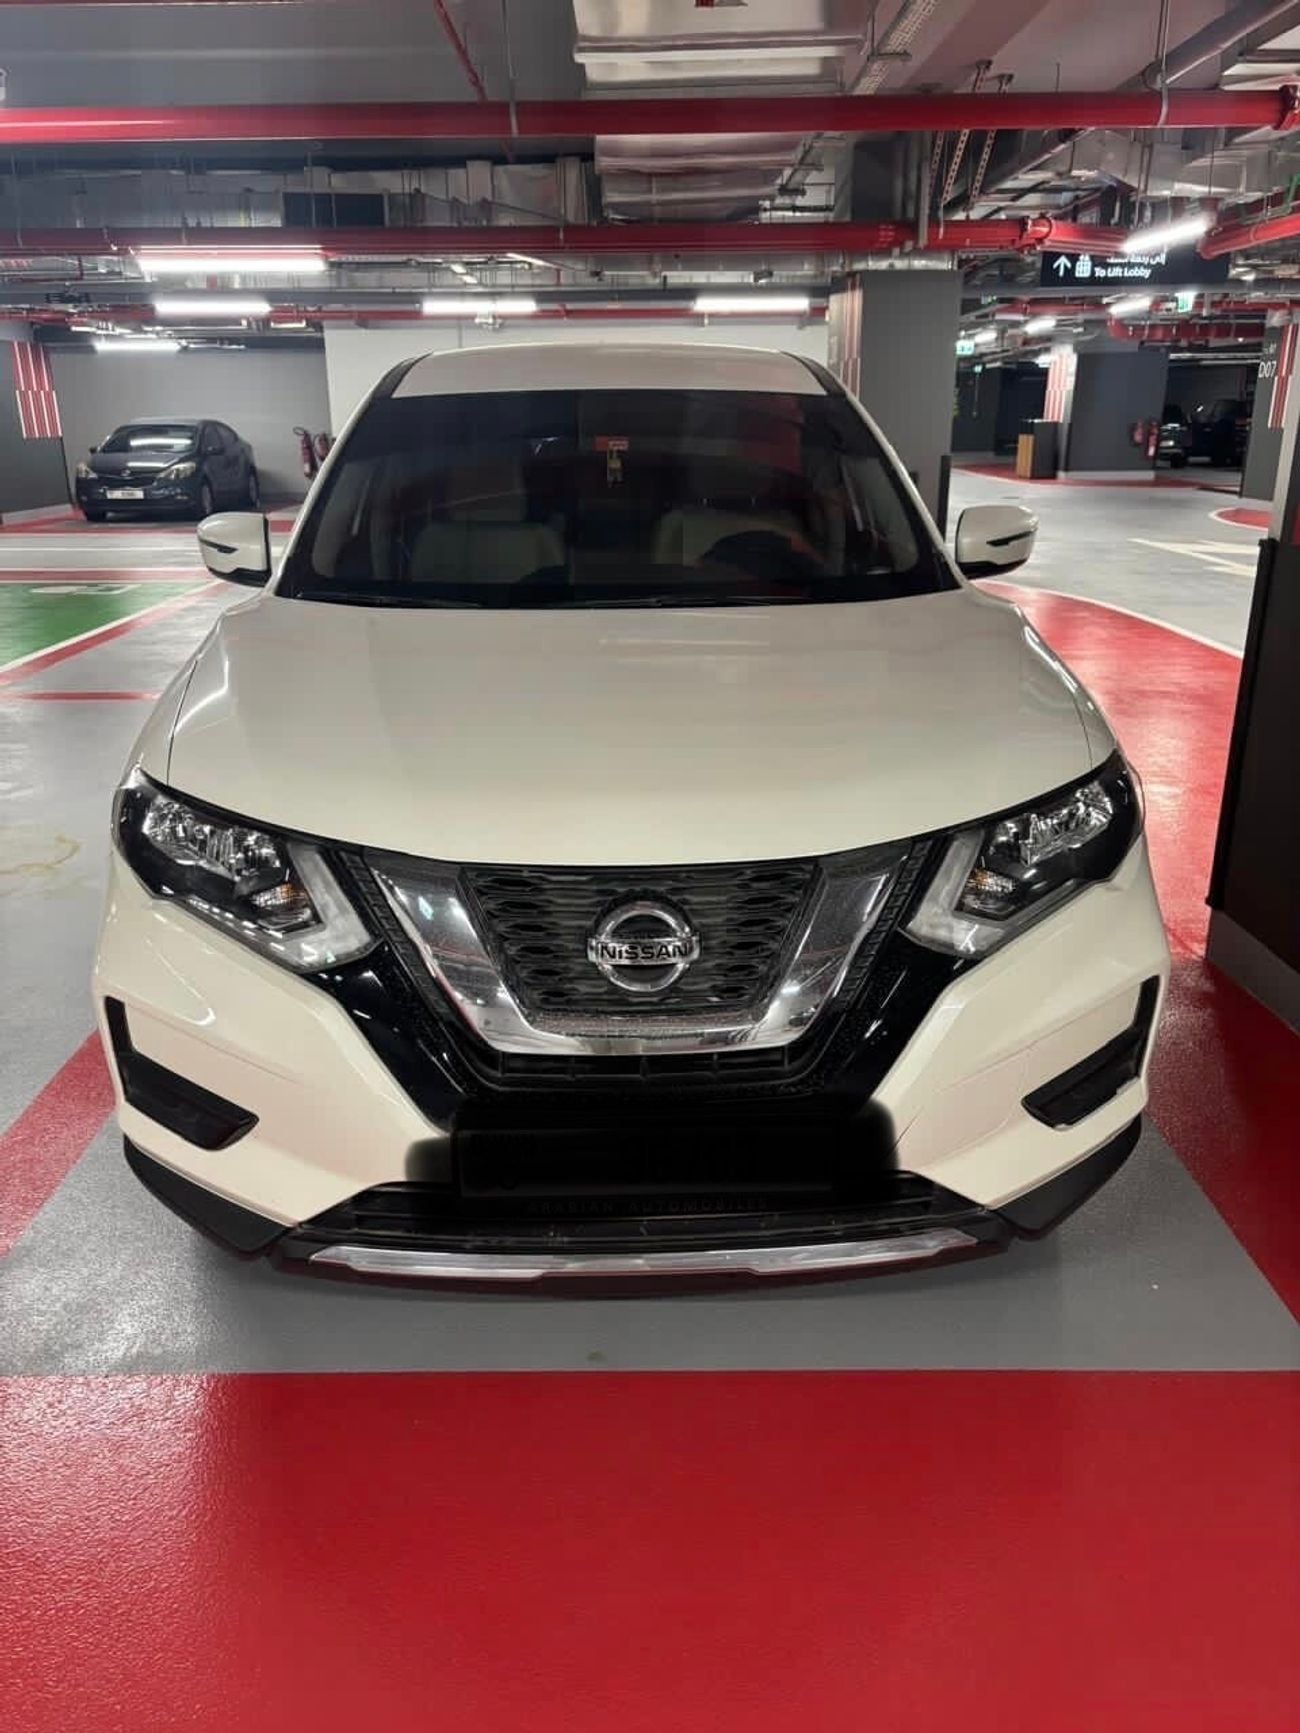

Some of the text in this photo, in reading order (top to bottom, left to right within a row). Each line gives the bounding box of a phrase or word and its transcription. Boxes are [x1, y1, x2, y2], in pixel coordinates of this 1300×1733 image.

[1094, 265, 1152, 279] To Lift Lobby
[1258, 360, 1277, 378] D07
[600, 944, 688, 961] NISSAN
[528, 1199, 768, 1215] ARABIAN AUTOMOBILES
